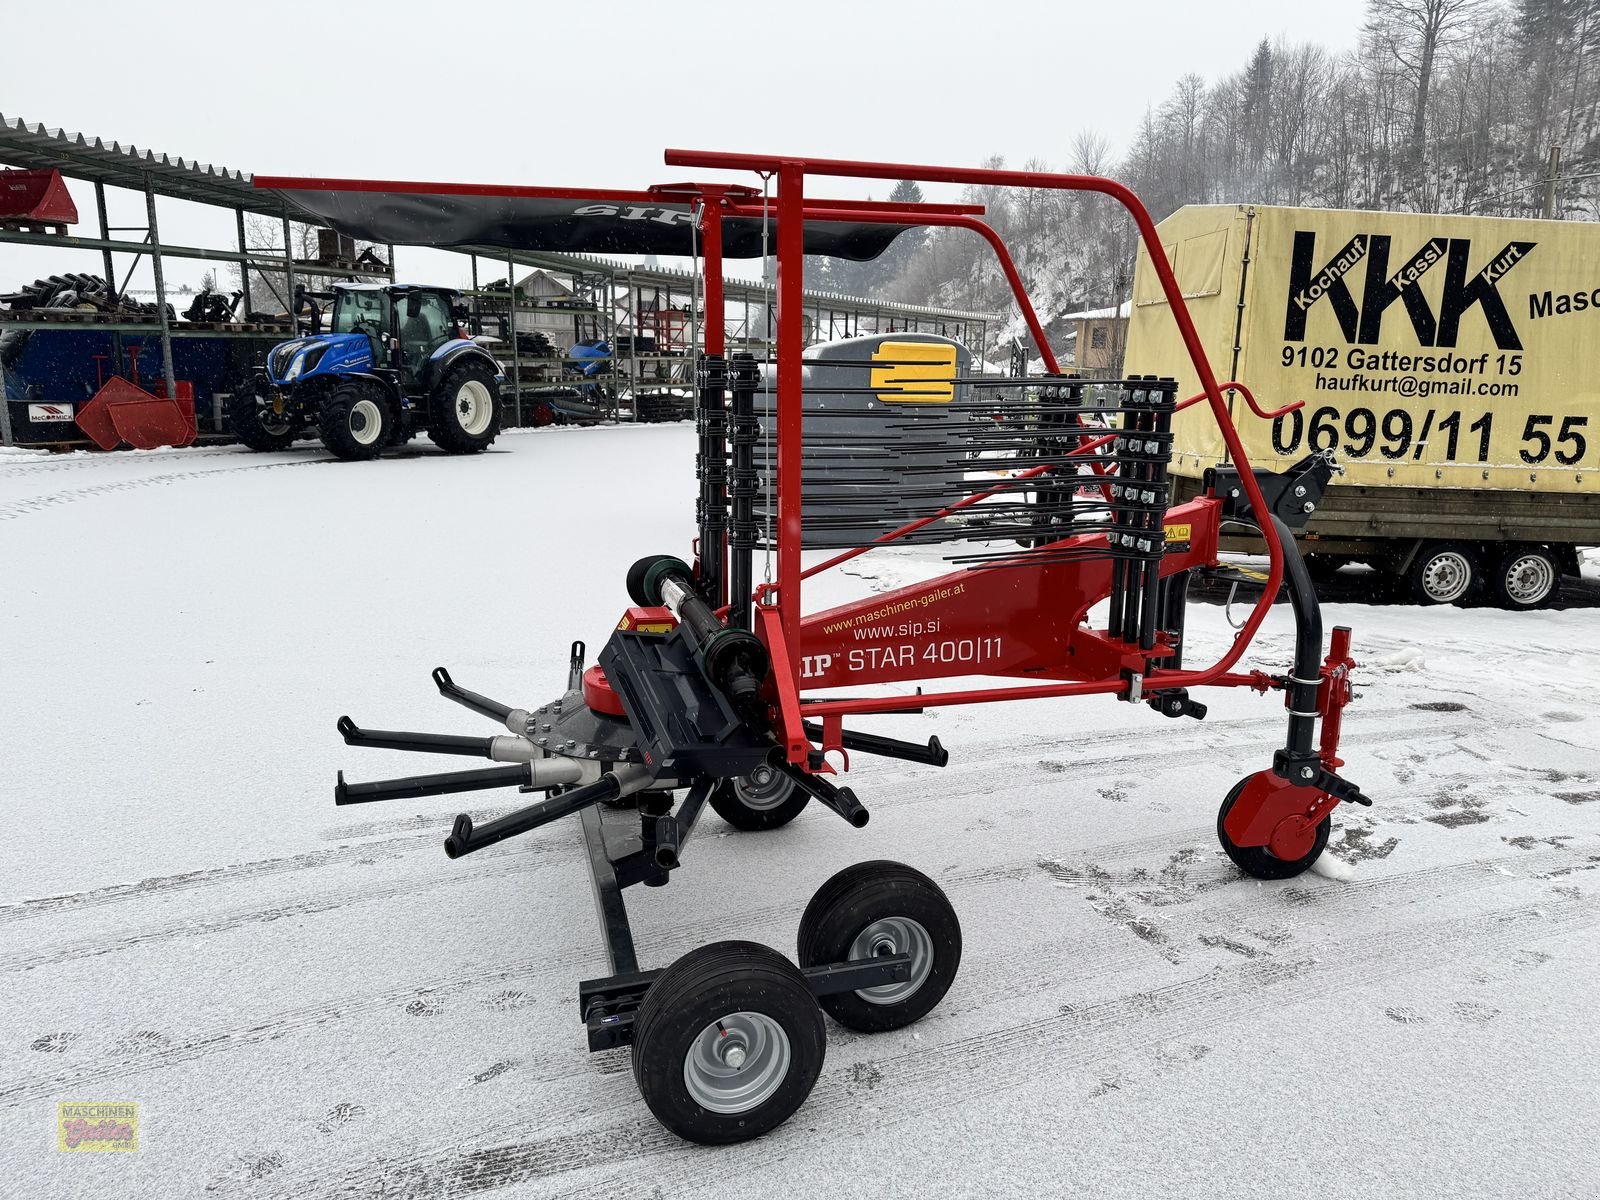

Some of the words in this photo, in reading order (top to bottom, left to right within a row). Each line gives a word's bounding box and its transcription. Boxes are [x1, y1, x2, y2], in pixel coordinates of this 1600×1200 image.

[1293, 238, 1366, 311] Kochauf
[1391, 241, 1443, 292] Kassl
[1480, 243, 1522, 285] Kurt
[1284, 230, 1538, 351] KKK
[1281, 345, 1339, 369] 9102
[1346, 348, 1489, 374] Gattersdorf
[1495, 354, 1523, 376] 15
[1314, 373, 1519, 398] haufkurt@gmail.com
[1271, 404, 1493, 462] 0699/11
[1518, 414, 1588, 466] 55
[823, 583, 965, 635] www.maschinen-gailer.at
[854, 617, 940, 641] www.sip.si
[848, 645, 915, 671] STAR
[922, 637, 1001, 664] 400|11
